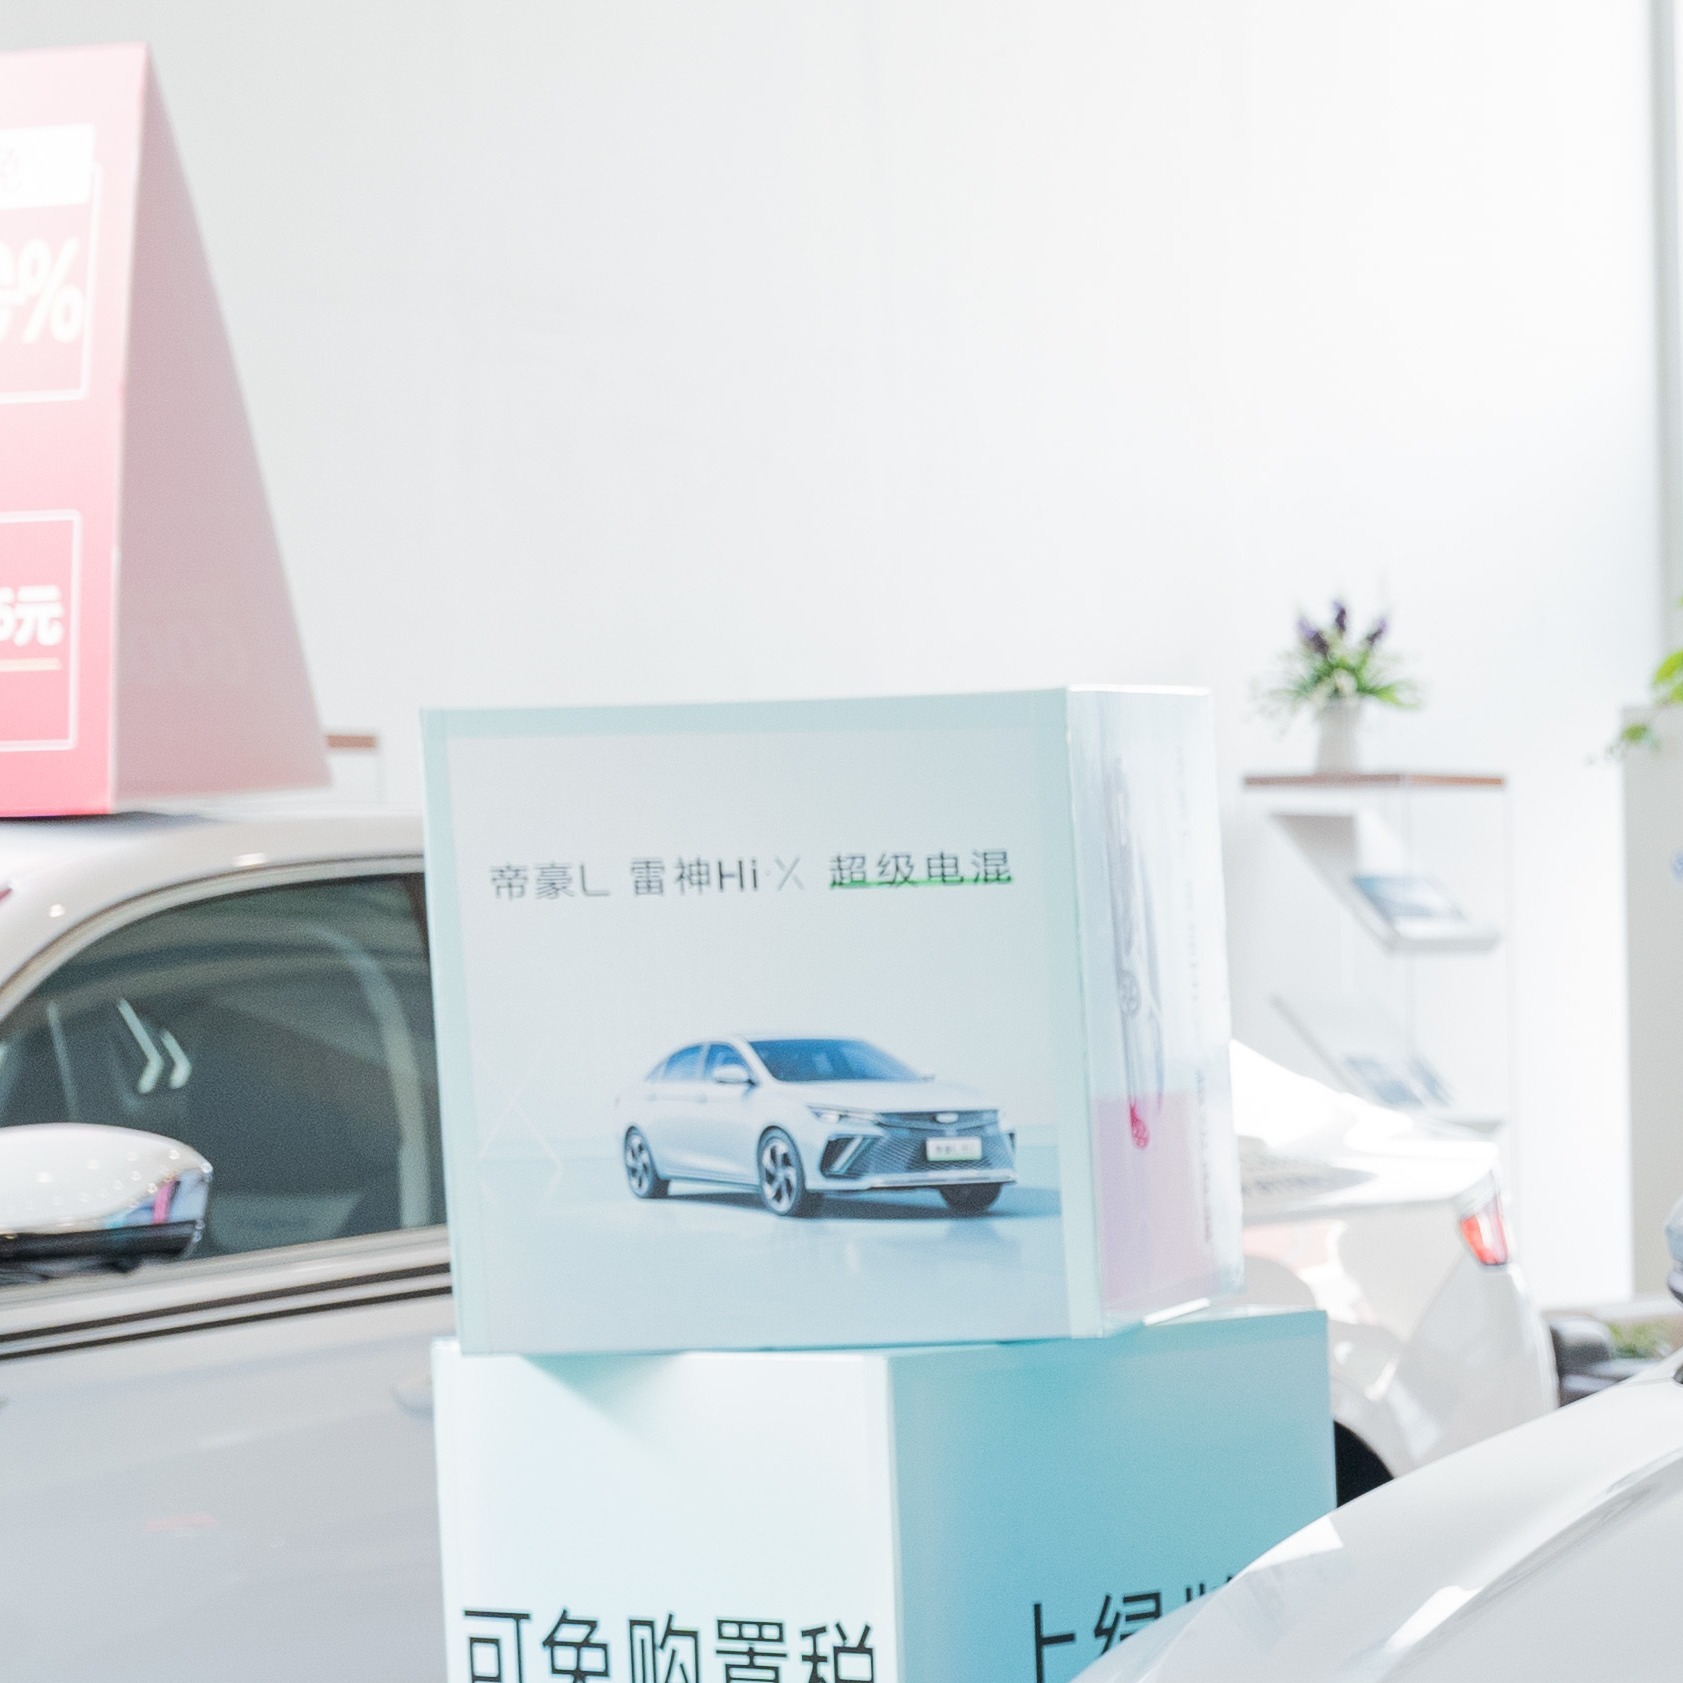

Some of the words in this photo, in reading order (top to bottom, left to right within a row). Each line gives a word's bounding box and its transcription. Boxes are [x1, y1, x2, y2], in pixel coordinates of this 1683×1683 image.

[489, 861, 611, 902] 帝豪L
[829, 848, 1013, 890] 超级电混
